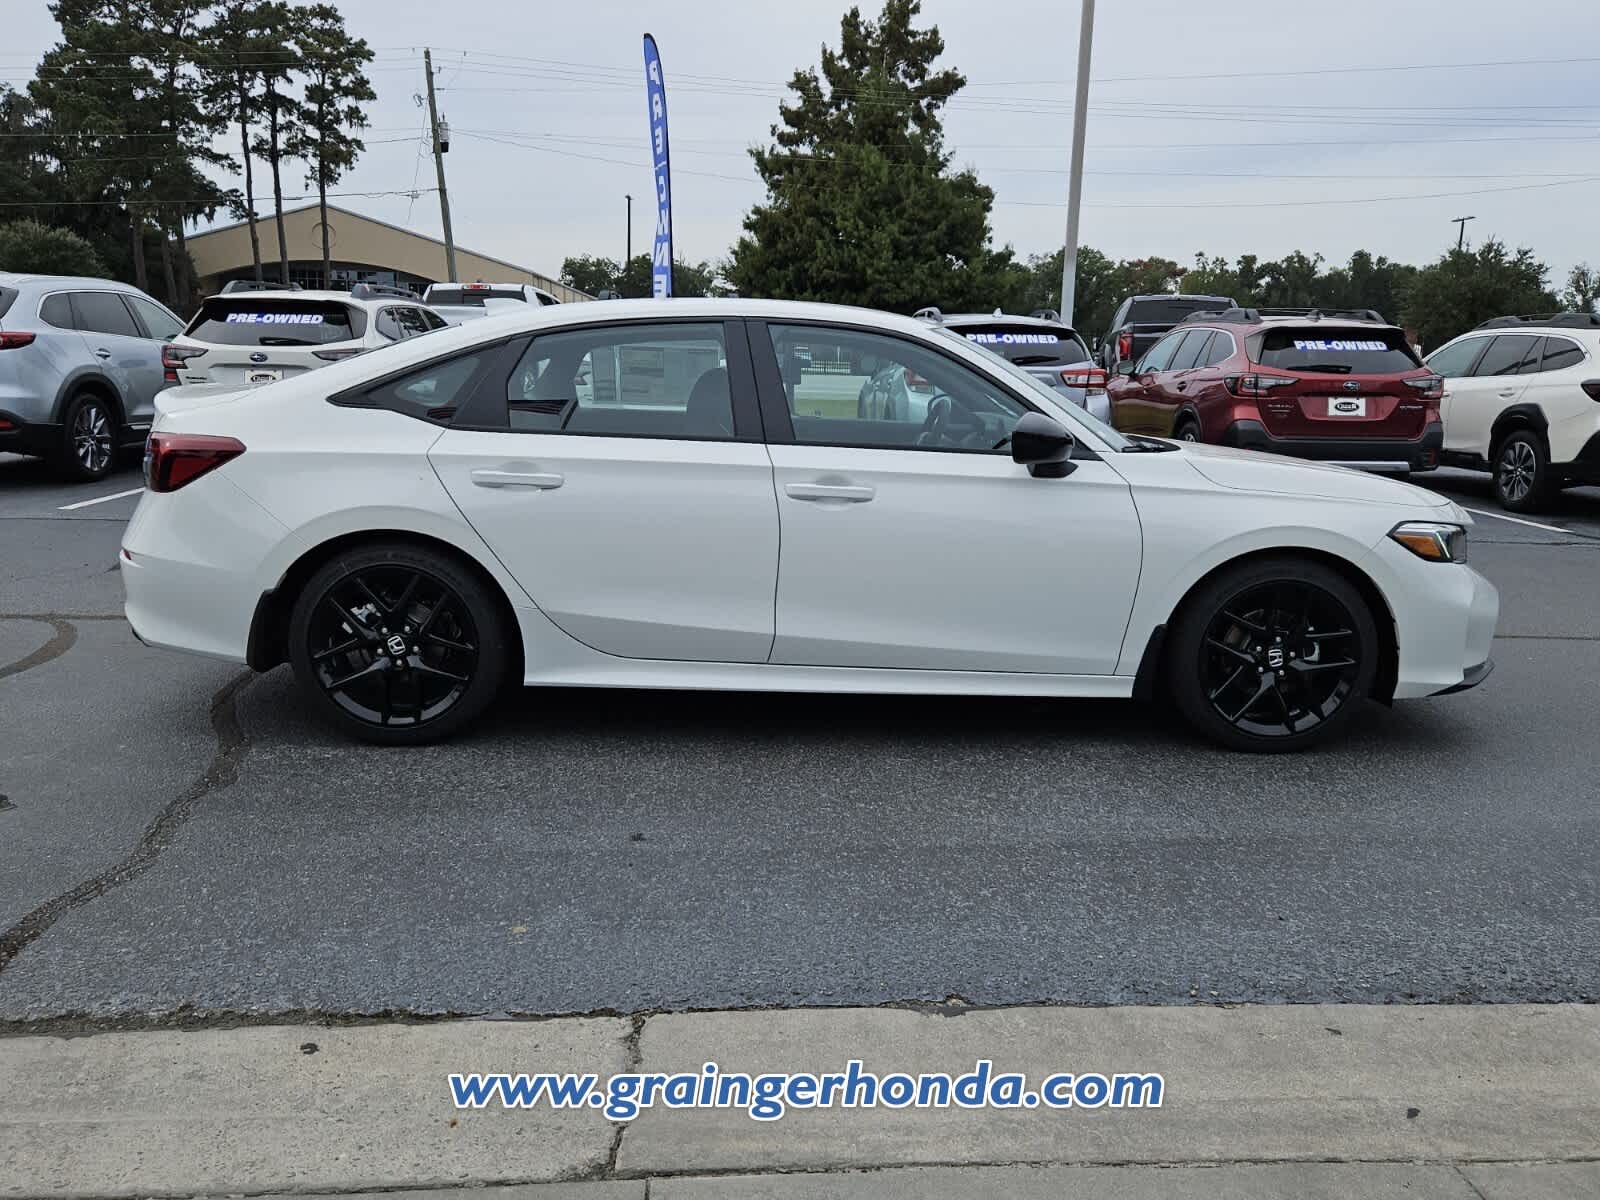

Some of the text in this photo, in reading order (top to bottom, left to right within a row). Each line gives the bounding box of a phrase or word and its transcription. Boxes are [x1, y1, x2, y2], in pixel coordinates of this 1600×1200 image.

[226, 313, 324, 324] PRE-OWNED
[966, 333, 1058, 344] PRE-OWNED
[1294, 340, 1388, 351] PRE-OWNED
